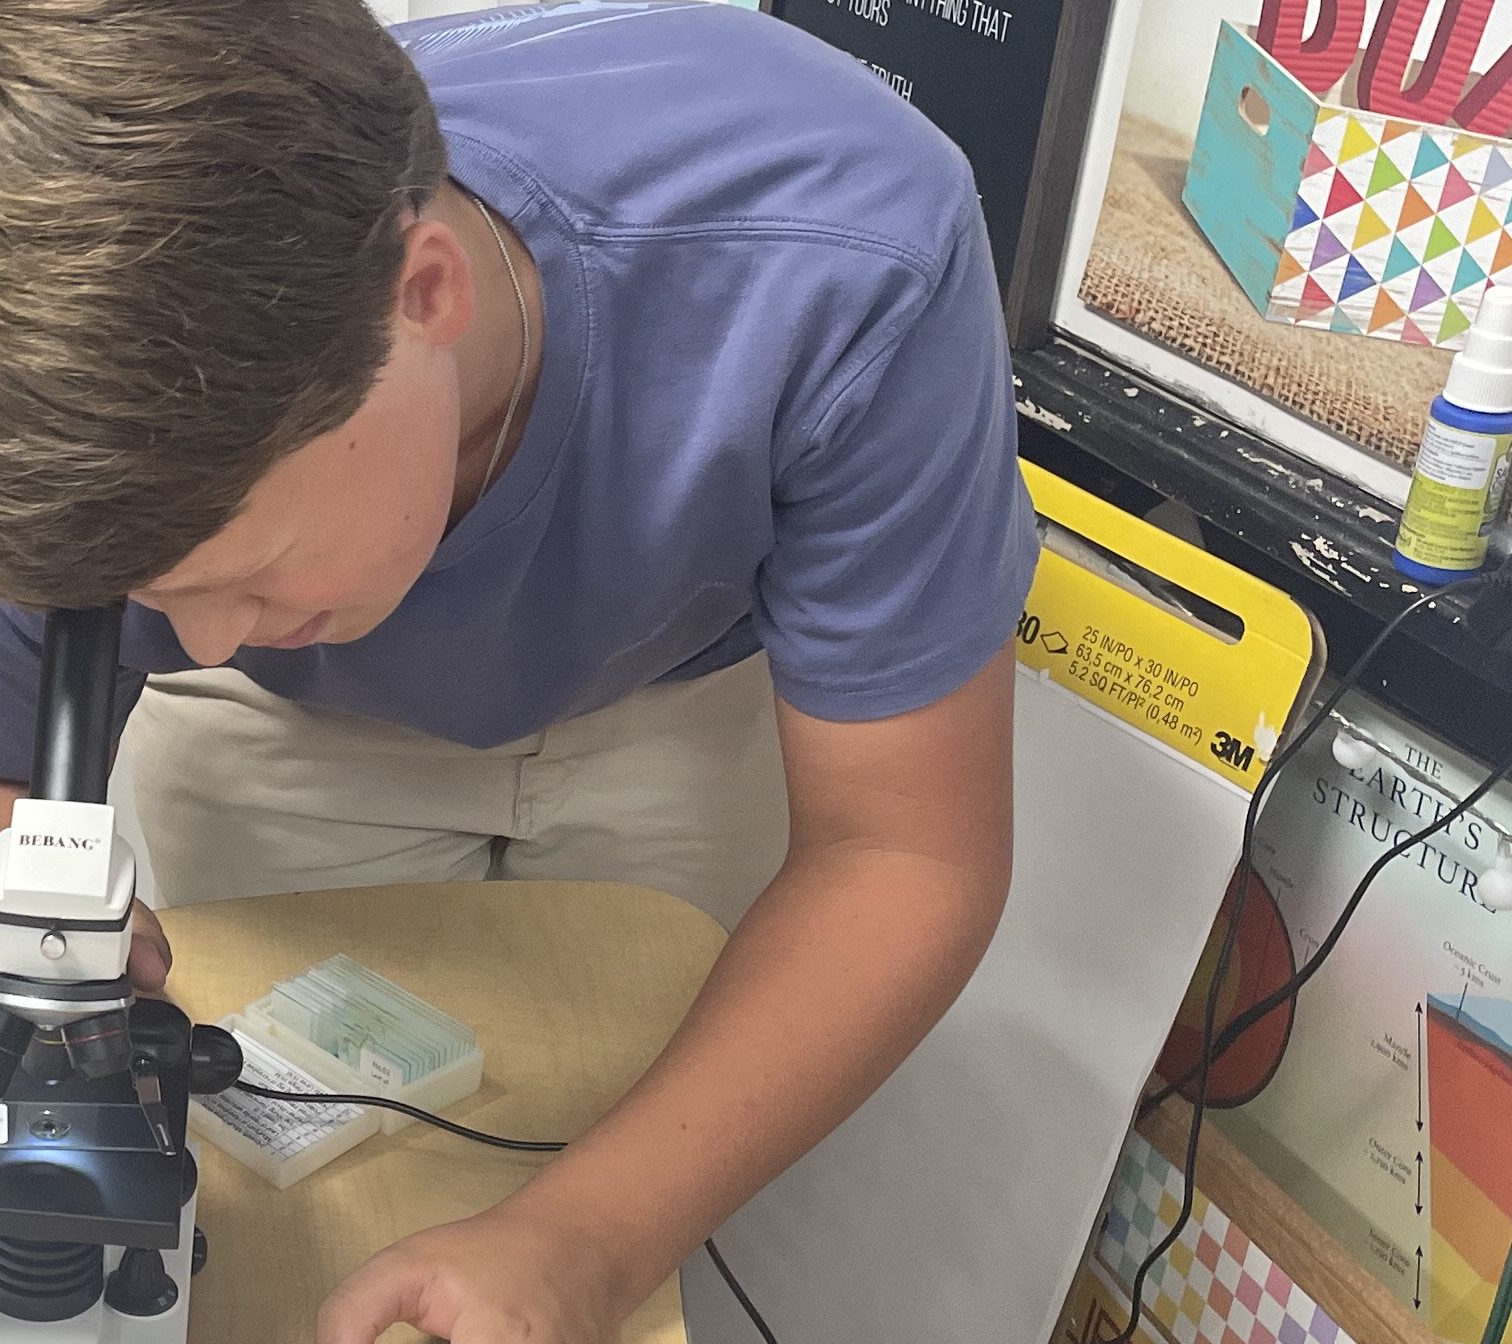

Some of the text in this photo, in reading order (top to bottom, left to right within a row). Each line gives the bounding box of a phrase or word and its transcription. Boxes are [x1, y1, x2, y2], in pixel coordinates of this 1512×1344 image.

[971, 0, 1013, 43] THAT
[1075, 643, 1185, 713] 63,5 cm x 76,2 cm
[1082, 625, 1199, 698] 25 IN/PO x 30 IN/PO
[1211, 731, 1255, 772] 3M
[1404, 744, 1443, 780] THE
[1313, 778, 1497, 914] STRUCTUR
